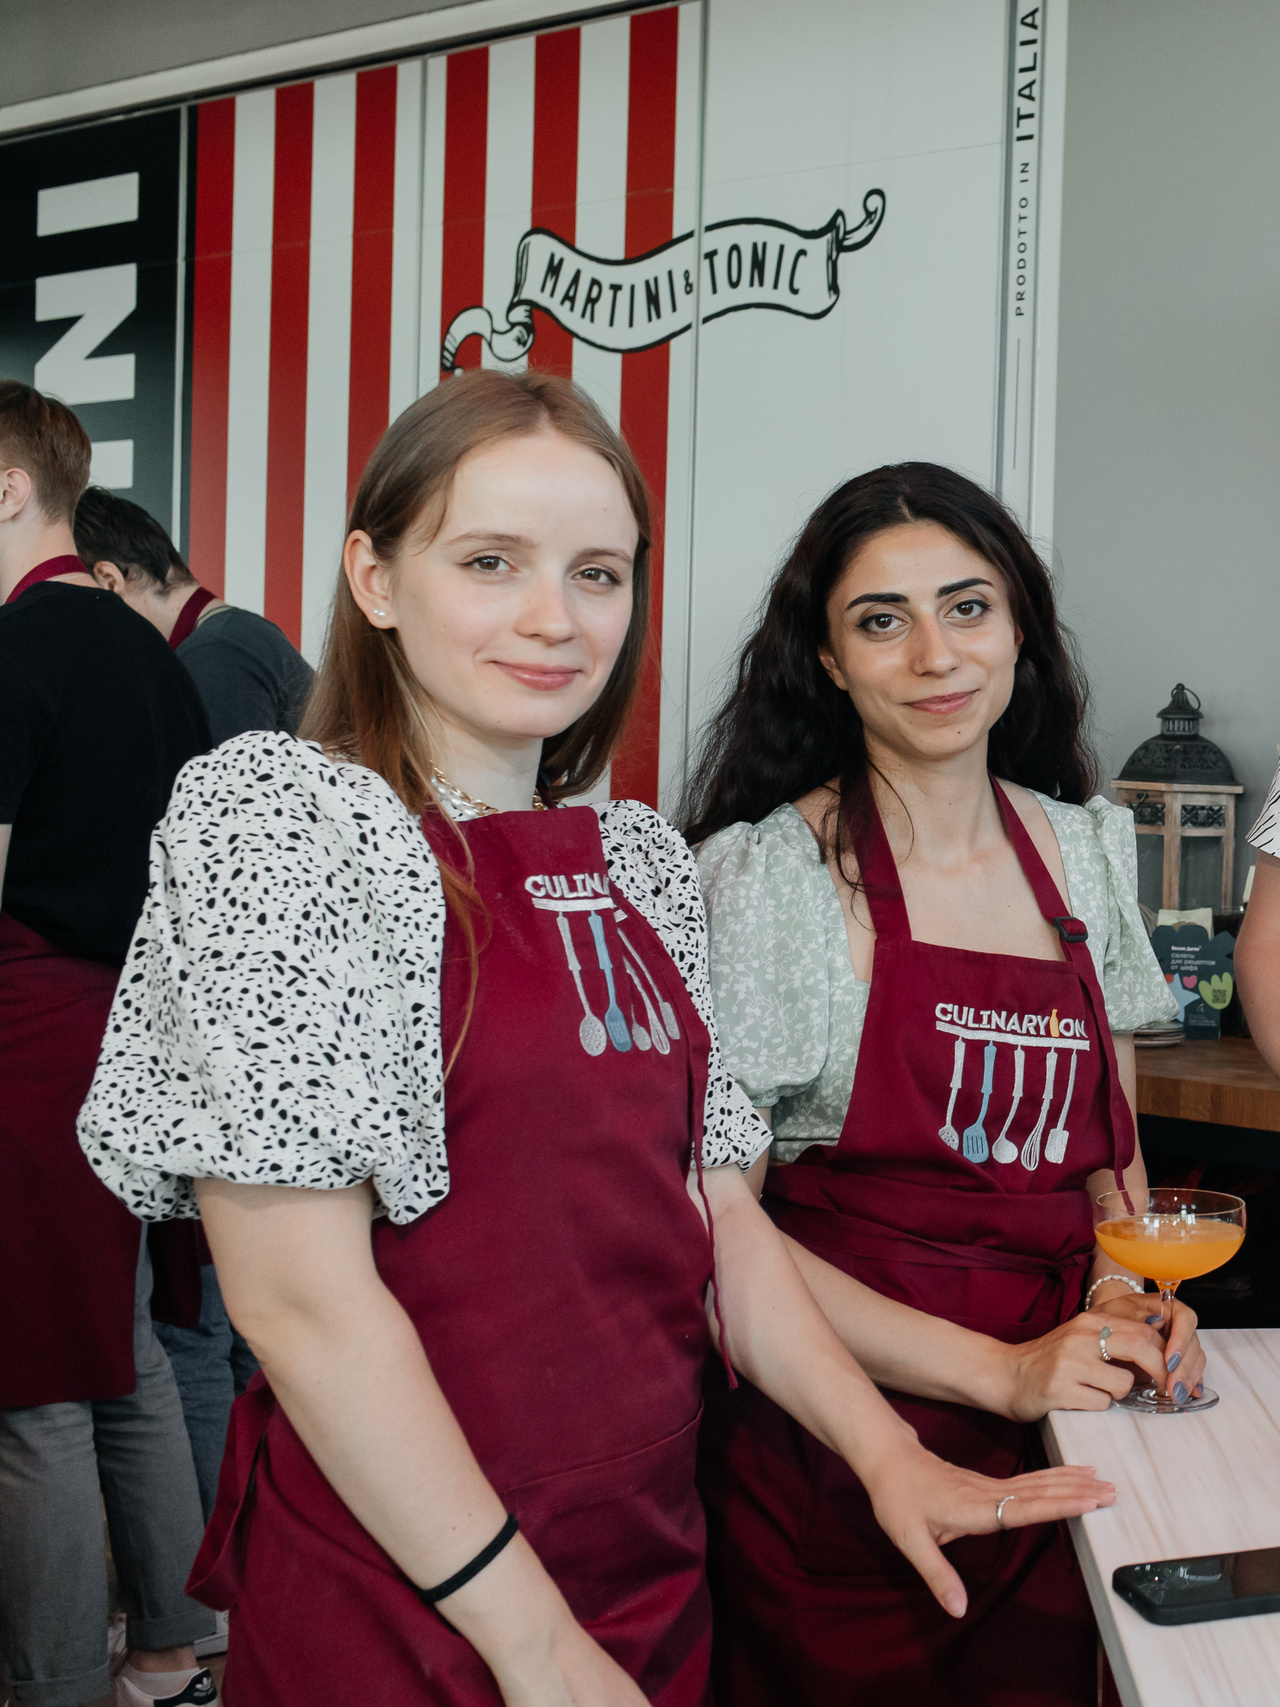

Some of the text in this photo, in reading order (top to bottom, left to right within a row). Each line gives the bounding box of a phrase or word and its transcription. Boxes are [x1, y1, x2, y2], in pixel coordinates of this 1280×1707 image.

[1015, 6, 1040, 318] PRODOTTO IN ITALIA
[540, 241, 808, 328] MARTINI & TONIC
